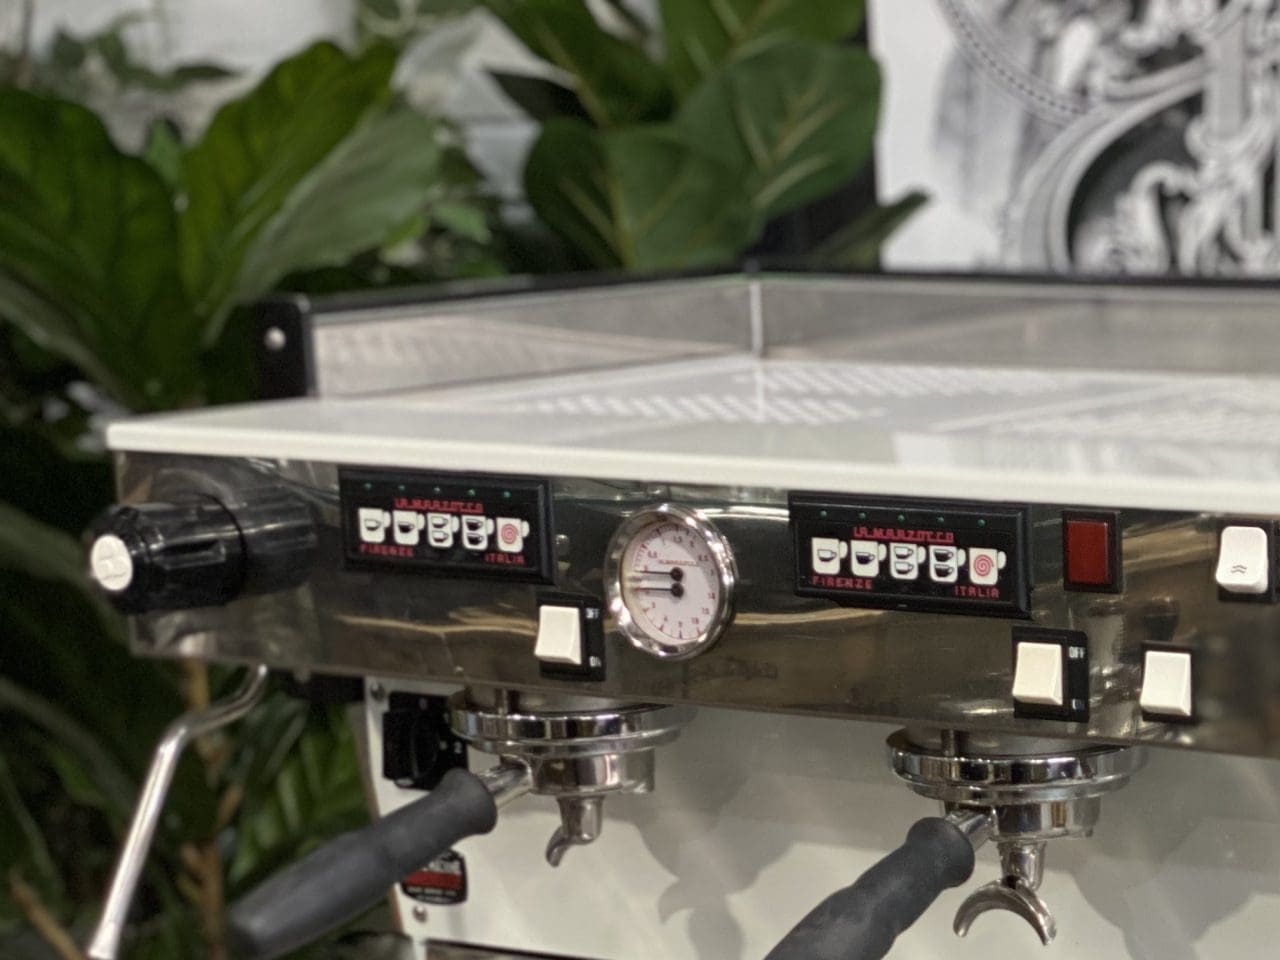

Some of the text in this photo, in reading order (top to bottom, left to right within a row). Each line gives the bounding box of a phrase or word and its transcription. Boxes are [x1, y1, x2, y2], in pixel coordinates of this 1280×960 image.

[360, 544, 414, 557] FIRENZE
[485, 553, 525, 565] ITALIA
[812, 575, 873, 590] FIRENZE
[955, 585, 1000, 598] ITALIA
[1069, 646, 1086, 658] OFF
